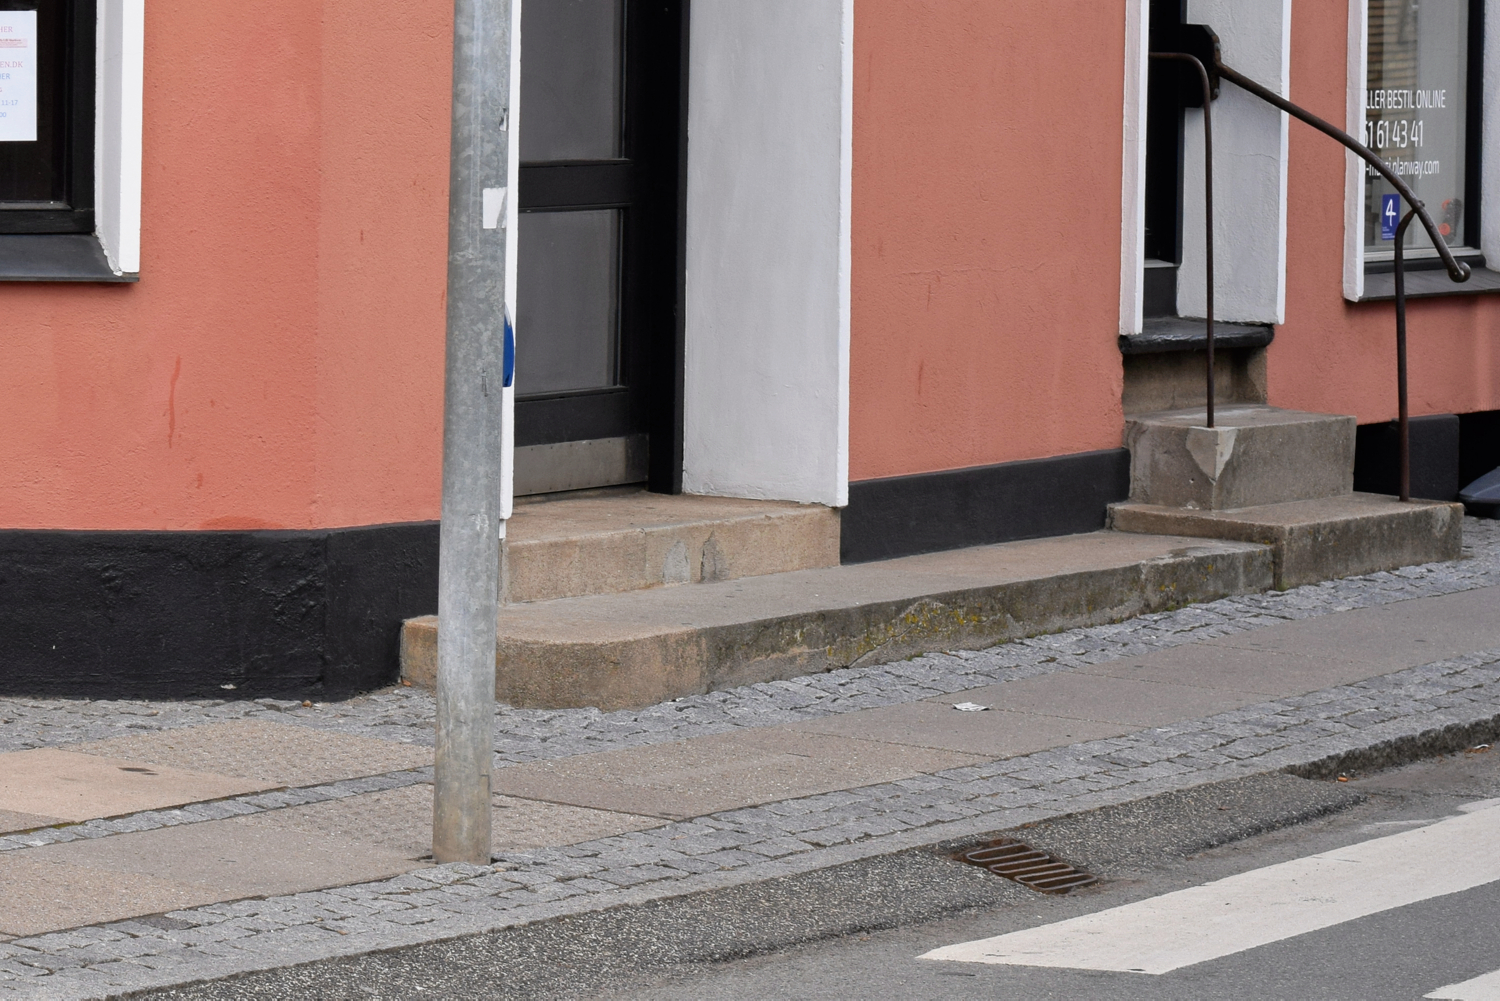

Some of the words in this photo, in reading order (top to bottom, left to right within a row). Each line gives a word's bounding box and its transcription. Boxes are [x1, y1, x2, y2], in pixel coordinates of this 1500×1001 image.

[1365, 90, 1385, 109] LLER
[1387, 90, 1415, 109] BESTIL
[1416, 89, 1446, 108] ONLINE
[1377, 120, 1389, 149] 61
[1392, 120, 1408, 148] 43
[1410, 120, 1423, 147] 41
